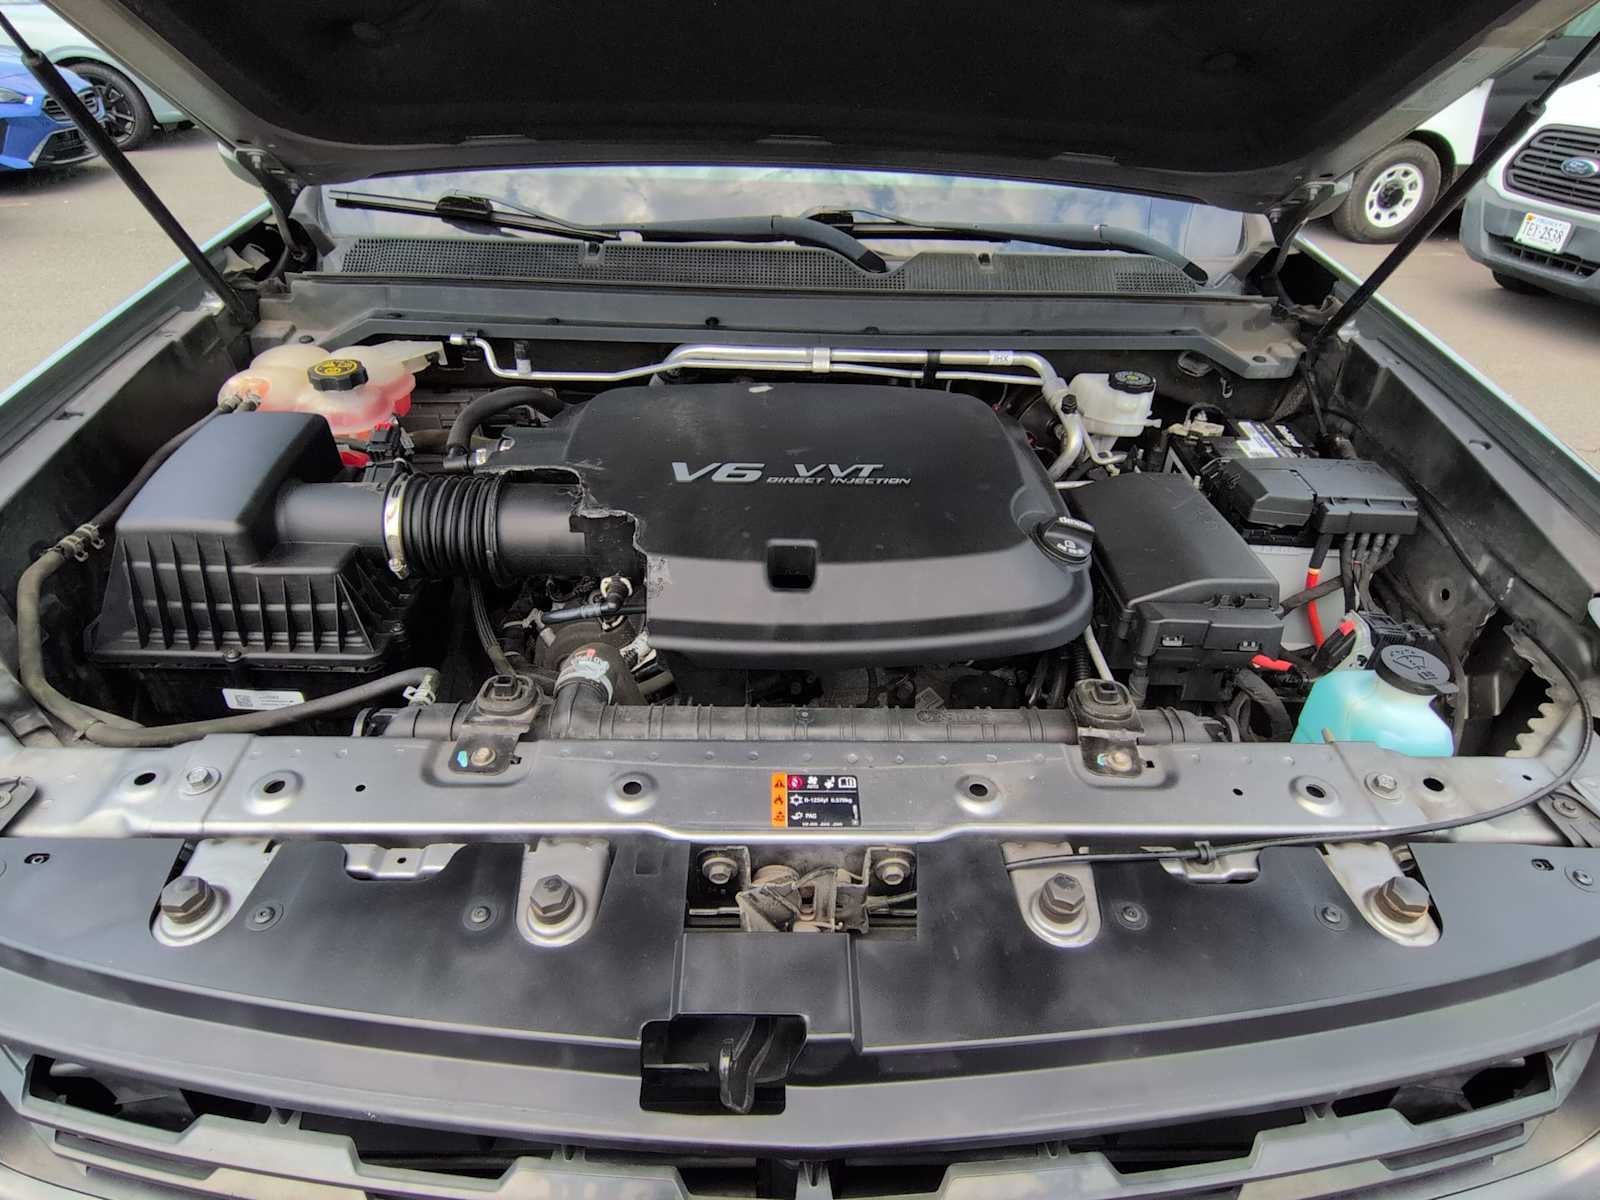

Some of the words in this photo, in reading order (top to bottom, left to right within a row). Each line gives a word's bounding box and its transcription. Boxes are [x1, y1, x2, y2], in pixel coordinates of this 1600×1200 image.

[671, 462, 765, 483] V6
[793, 463, 884, 477] VVT
[766, 476, 825, 485] DIRECT
[829, 476, 911, 485] INJECTION
